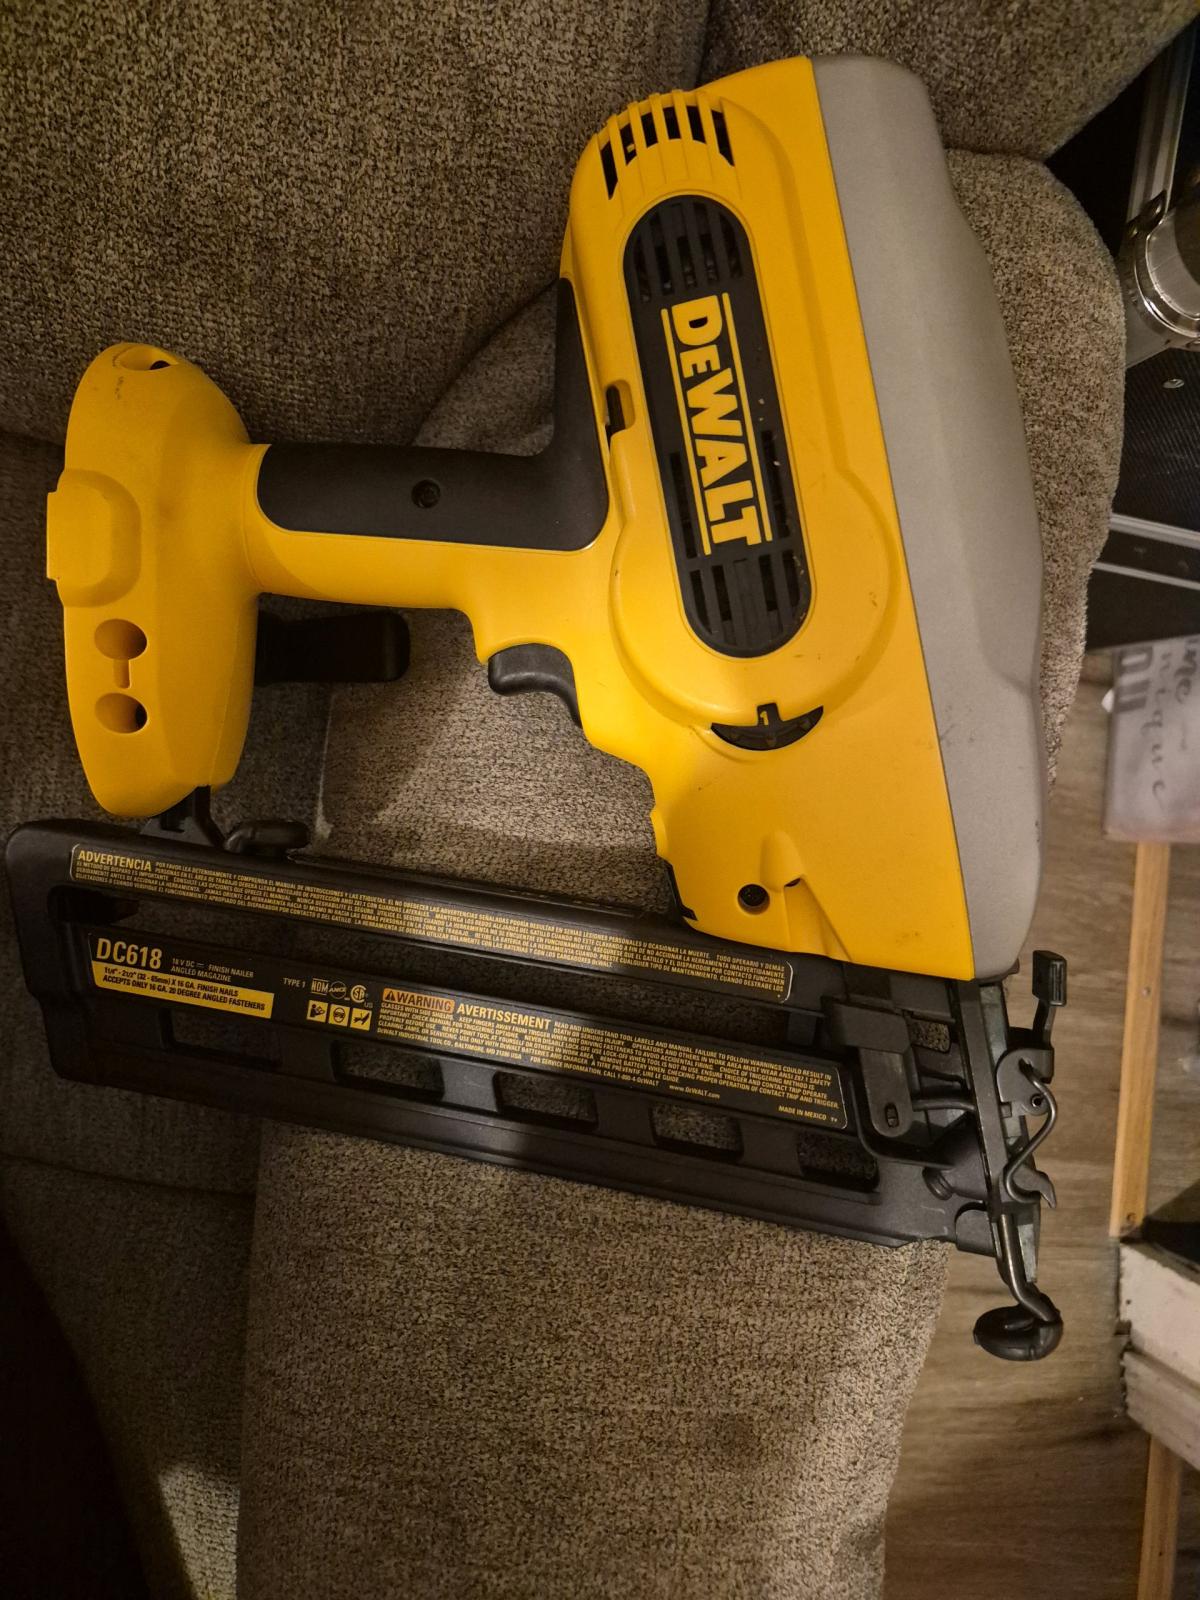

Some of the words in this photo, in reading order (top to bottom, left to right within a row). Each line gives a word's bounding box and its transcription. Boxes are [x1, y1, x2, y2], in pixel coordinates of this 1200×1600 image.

[672, 294, 761, 547] DEWALT
[78, 850, 152, 872] ADVERTENCIA
[96, 937, 162, 969] DC618
[171, 965, 196, 976] ANGLED
[197, 970, 231, 982] MAGAZINE
[208, 964, 229, 974] FINISH
[230, 968, 253, 978] NAILER
[282, 977, 300, 987] TYPE
[102, 974, 130, 985] ACCEPTS
[131, 980, 148, 988] ONLY
[156, 984, 168, 992] GA.
[177, 988, 200, 998] DEGREE
[202, 992, 227, 1003] ANGLED
[228, 997, 265, 1010] FASTENERS
[185, 981, 195, 989] GA.
[197, 983, 218, 993] FINISH
[219, 987, 238, 996] NAILS
[397, 991, 451, 1011] WARNING
[456, 1003, 551, 1030] AVERTISSEMENT
[582, 1026, 618, 1038] UNDERSTAND
[634, 1037, 654, 1045] LABELS
[695, 1048, 716, 1057] FAILURE
[726, 1054, 748, 1063] FOLLOW
[750, 1059, 781, 1070] WARNINGS
[782, 1066, 801, 1074] COULD
[802, 1069, 822, 1078] RESULT
[631, 1042, 663, 1053] OPERATORS
[678, 1052, 699, 1060] OTHERS
[809, 1077, 830, 1086] SAFETY
[718, 1079, 749, 1090] OPERATION
[759, 1087, 785, 1097] CONTACT
[723, 1074, 747, 1083] TRIGGER
[761, 1081, 786, 1090] CONTACT
[802, 1089, 827, 1098] OPERATE
[749, 1072, 782, 1083] TRIGGERING
[783, 1079, 807, 1087] METHOD
[778, 1105, 795, 1114] MADE
[804, 1110, 826, 1120] MEXICO
